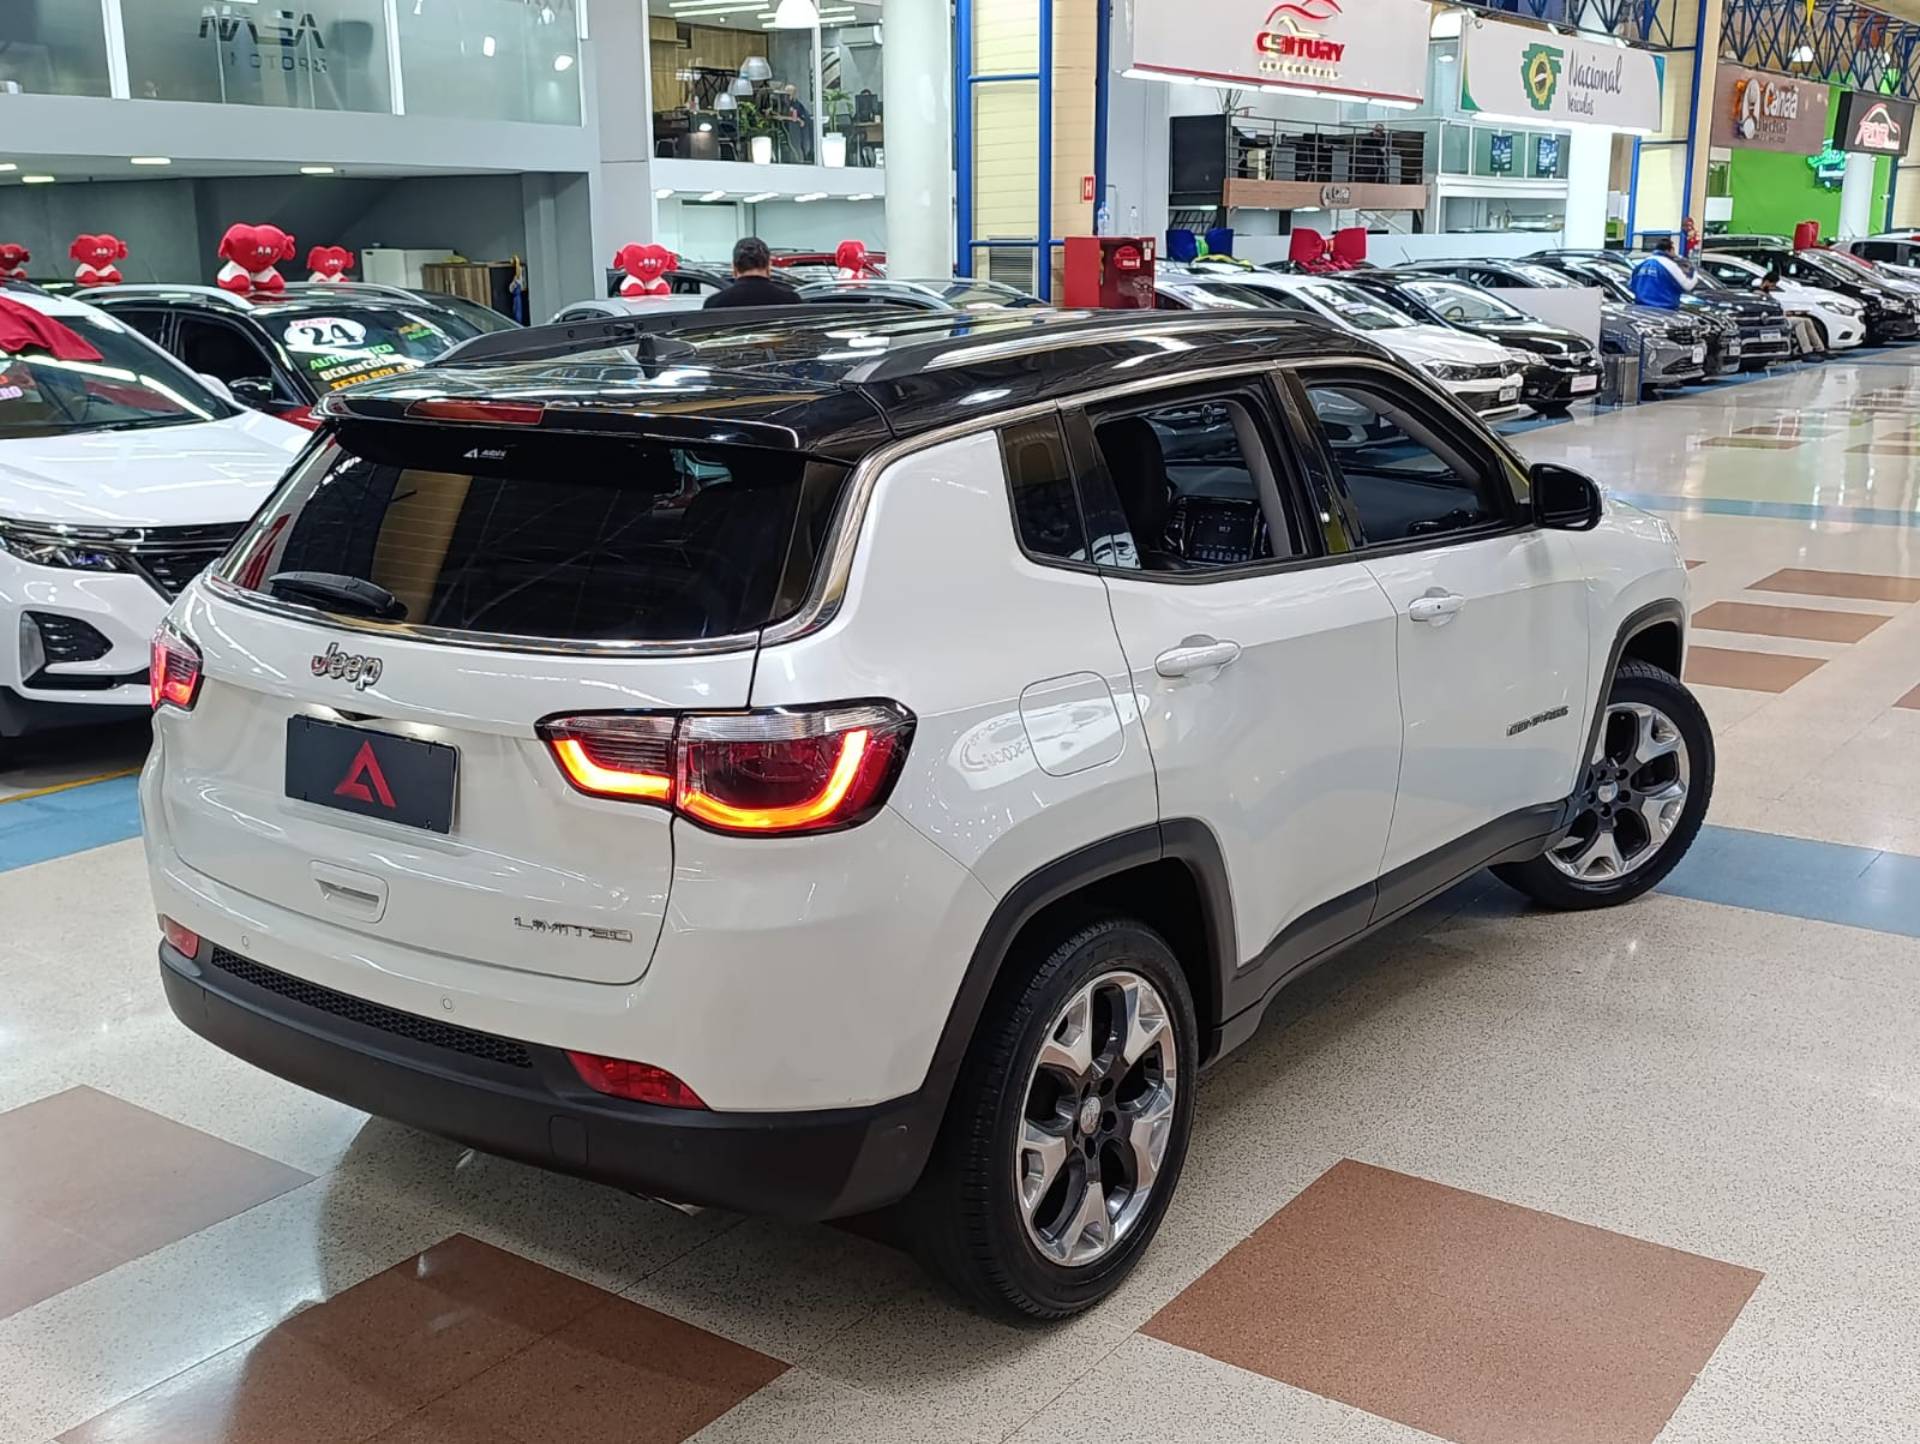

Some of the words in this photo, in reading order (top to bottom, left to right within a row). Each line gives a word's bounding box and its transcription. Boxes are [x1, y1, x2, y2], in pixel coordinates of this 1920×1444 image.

[1256, 31, 1345, 62] CENTURY
[1568, 48, 1622, 95] Nacional
[299, 324, 360, 346] 24
[311, 642, 383, 691] Jeep
[513, 917, 633, 943] LIMITED
